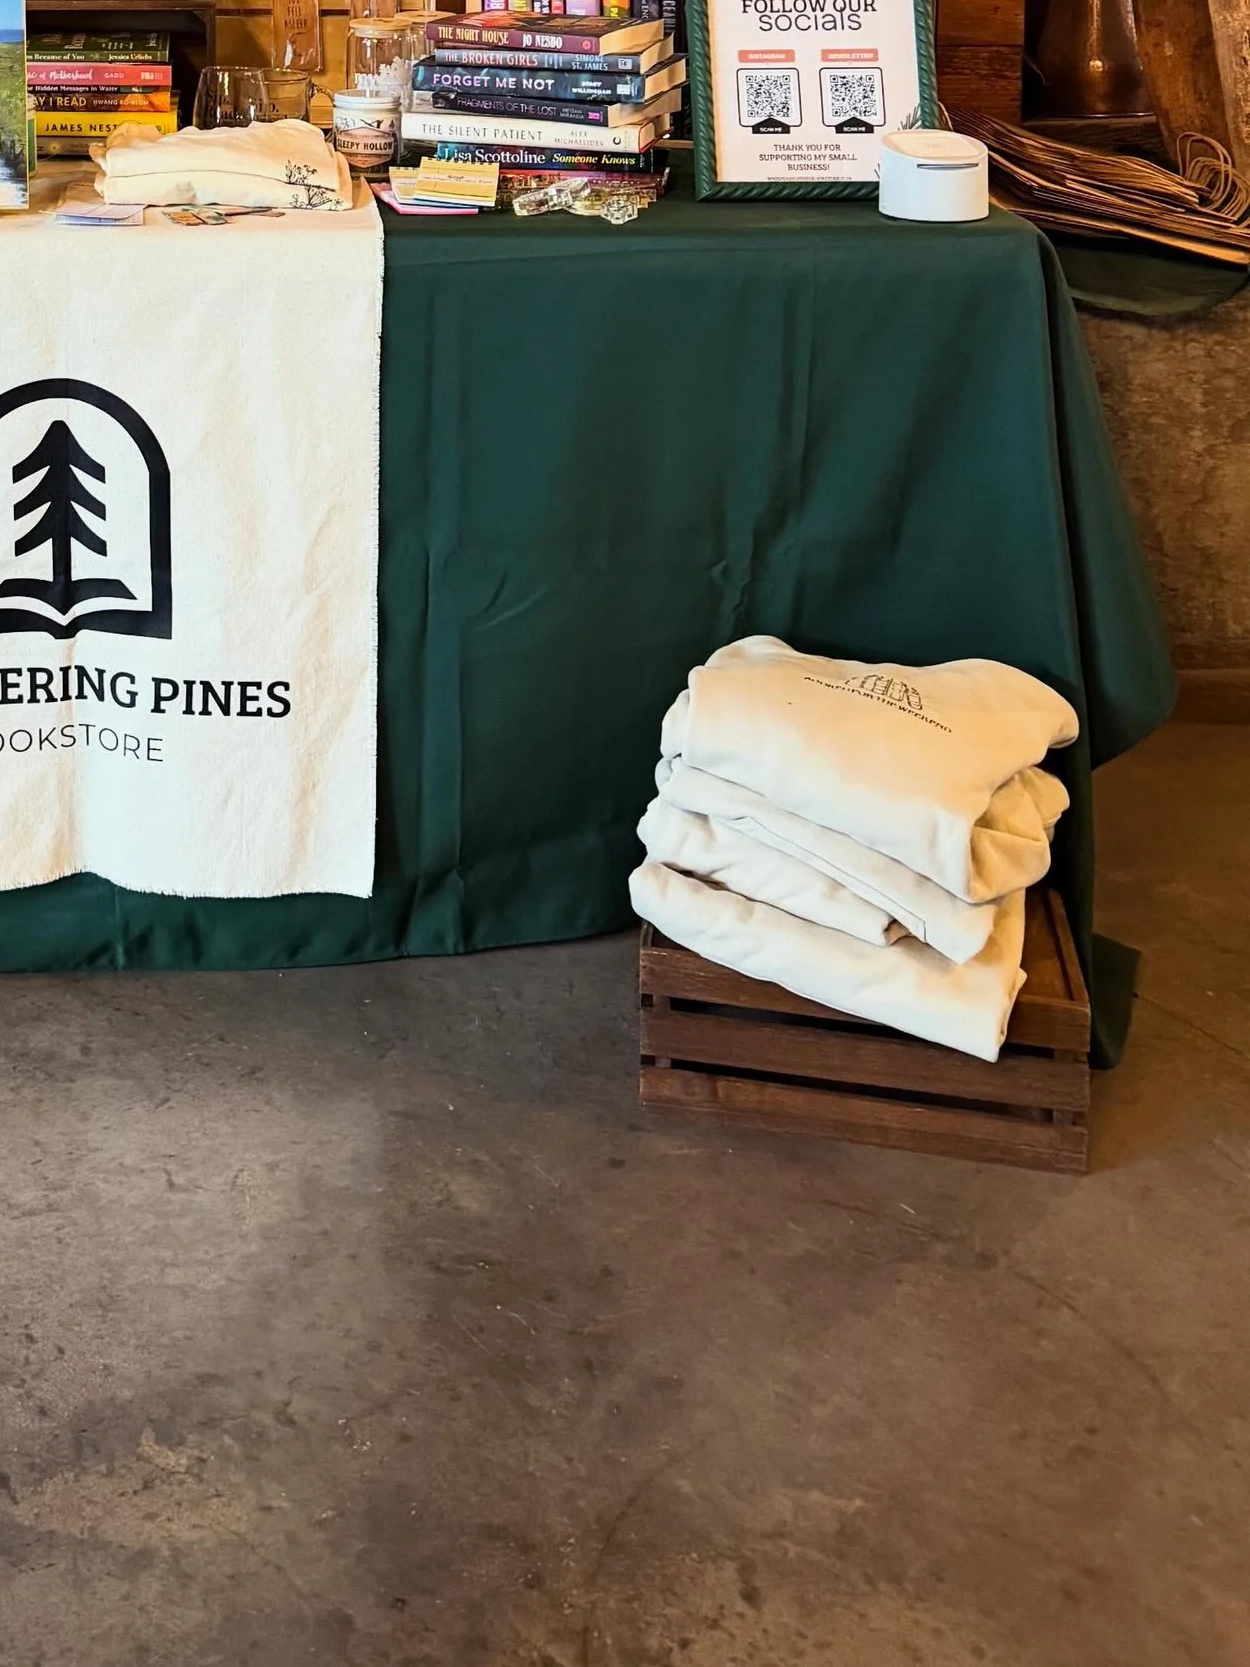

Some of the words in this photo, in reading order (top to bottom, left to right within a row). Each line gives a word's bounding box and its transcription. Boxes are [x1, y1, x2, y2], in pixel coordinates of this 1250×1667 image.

[438, 26, 454, 39] THE
[456, 27, 481, 42] NIGHT
[483, 28, 510, 45] HOUSE
[522, 34, 533, 49] JO
[444, 52, 459, 63] THE
[461, 52, 503, 65] BROKEN
[506, 53, 538, 66] GIRLS
[574, 54, 604, 63] SIMONE
[572, 62, 583, 70] ST.
[584, 62, 608, 71] JAMES
[432, 73, 490, 88] FORGET
[495, 77, 517, 89] ME
[522, 78, 555, 90] NOT
[57, 97, 87, 106] READ
[457, 98, 505, 110] FRAGMENTS
[506, 101, 519, 112] OF
[520, 102, 536, 114] THE
[537, 105, 557, 116] LOST
[45, 124, 82, 132] JAMES
[422, 124, 443, 135] THE
[448, 125, 487, 138] SILENT
[494, 128, 542, 141] PATIENT
[337, 139, 360, 149] SLEEPY
[364, 142, 392, 150] HOLLOW
[773, 144, 804, 152] THANK
[443, 147, 472, 162] Lisa
[474, 148, 546, 164] Scottoline
[552, 153, 598, 164] Someone
[600, 154, 636, 165] Knows
[759, 153, 812, 162] SUPPORTING
[829, 153, 858, 161] SMALL
[787, 163, 830, 171] BUSINESS!
[149, 676, 292, 719] PINES
